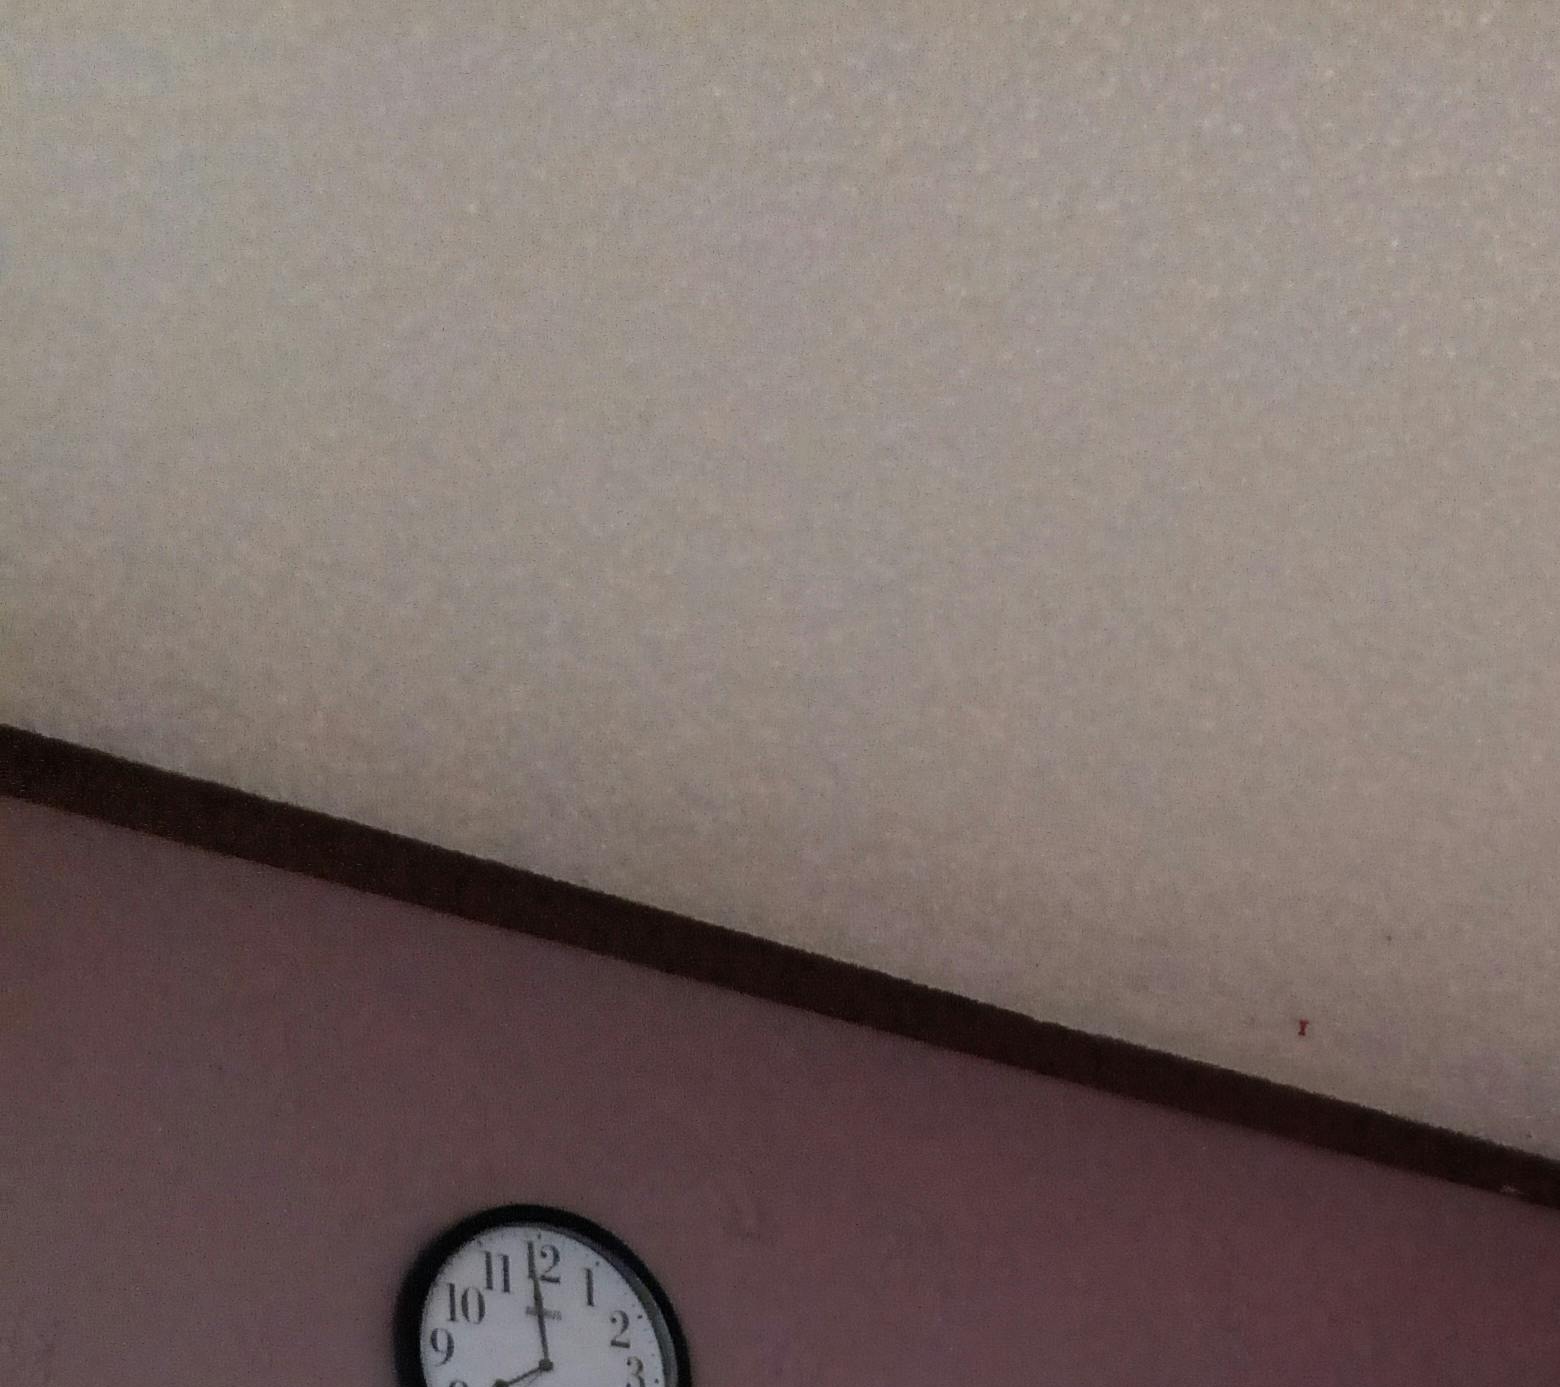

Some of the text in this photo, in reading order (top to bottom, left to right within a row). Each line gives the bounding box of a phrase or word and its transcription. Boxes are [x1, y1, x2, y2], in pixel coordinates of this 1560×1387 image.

[484, 1251, 511, 1293] 11
[527, 1241, 561, 1284] 12
[448, 1283, 486, 1324] 10
[584, 1268, 595, 1307] 1
[430, 1327, 454, 1367] 9
[610, 1310, 631, 1349] 2
